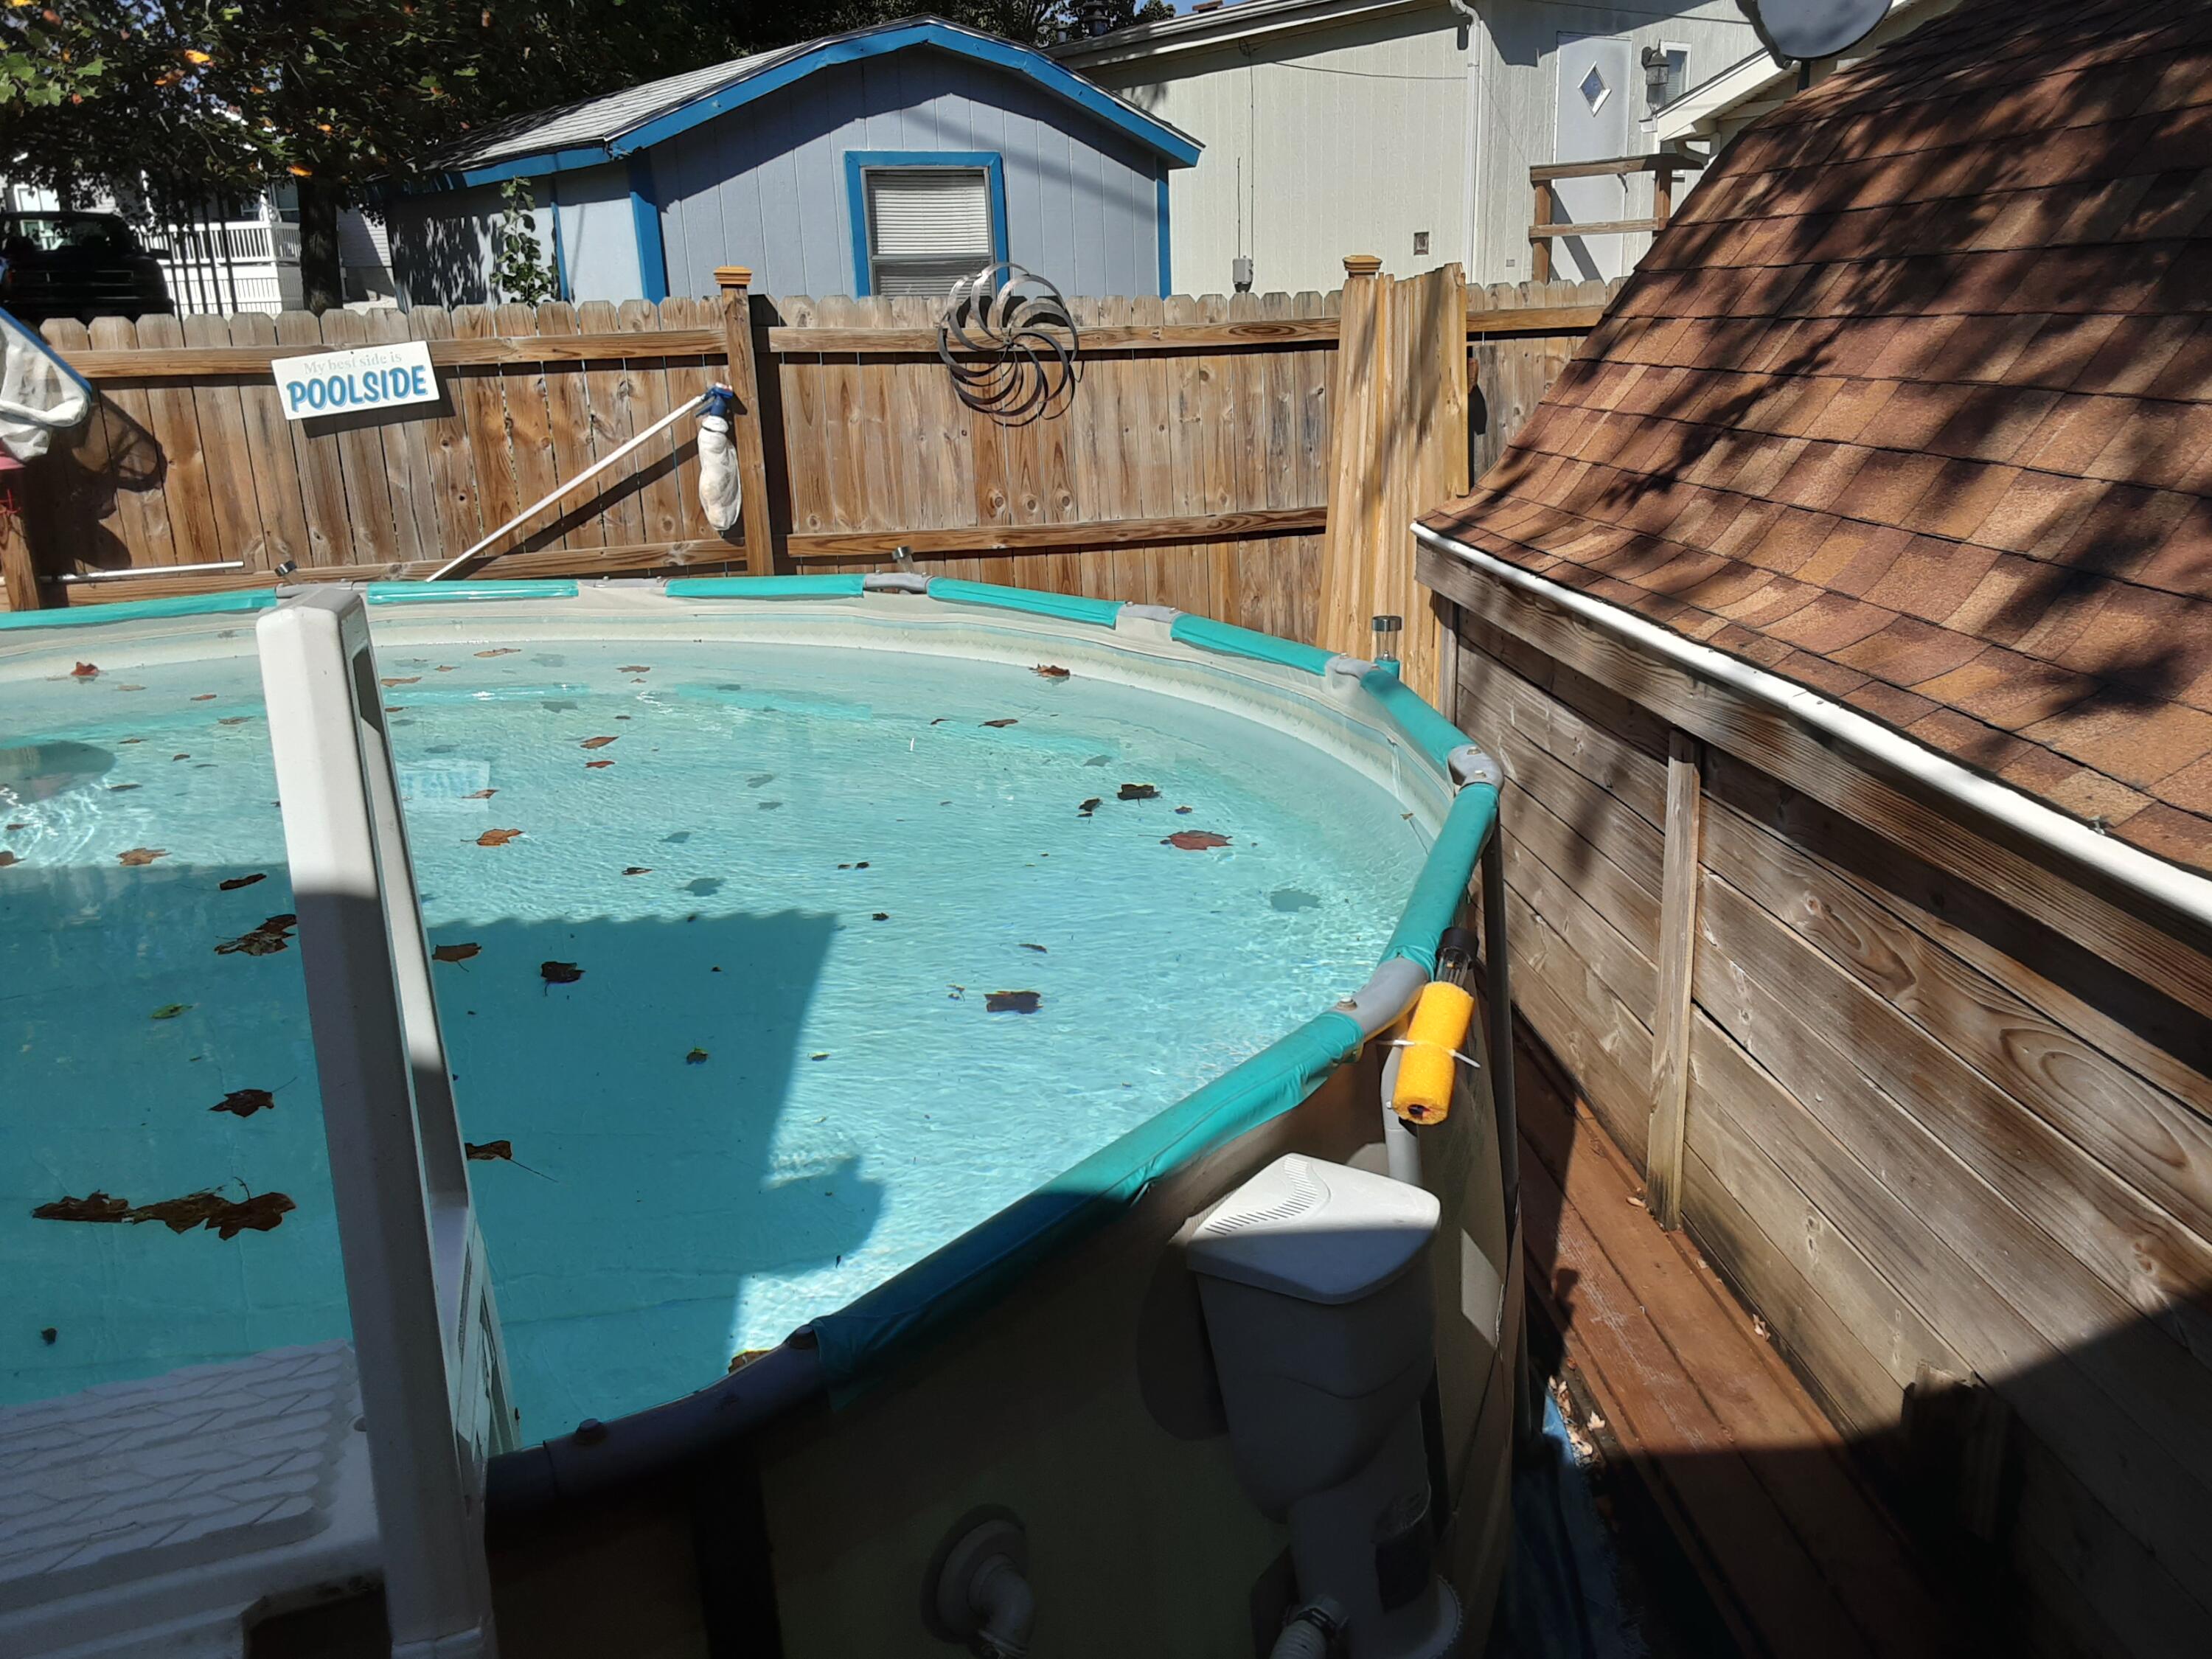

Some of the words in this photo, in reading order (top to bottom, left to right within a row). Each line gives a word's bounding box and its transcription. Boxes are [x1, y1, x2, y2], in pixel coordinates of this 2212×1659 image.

[304, 361, 325, 375] My
[327, 358, 356, 371] best
[359, 354, 387, 367] side
[391, 351, 402, 363] is
[286, 365, 428, 412] POOLSIDE
